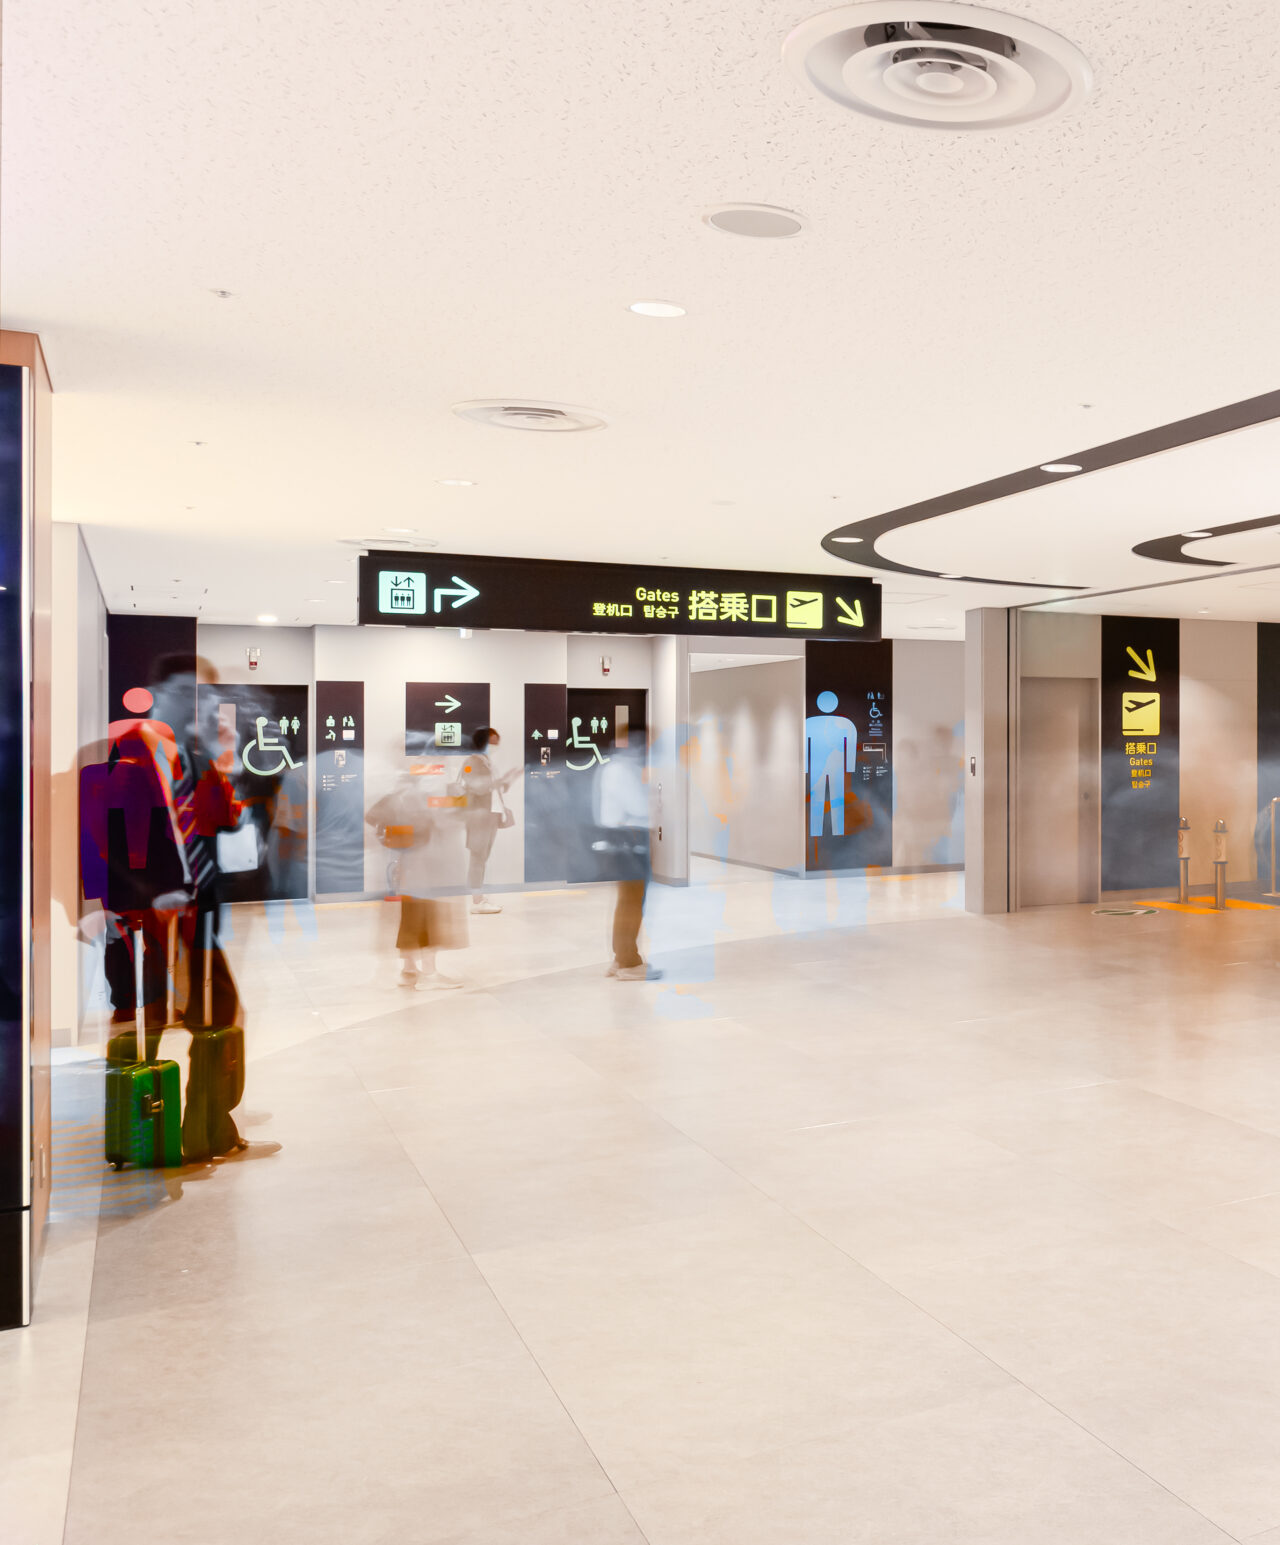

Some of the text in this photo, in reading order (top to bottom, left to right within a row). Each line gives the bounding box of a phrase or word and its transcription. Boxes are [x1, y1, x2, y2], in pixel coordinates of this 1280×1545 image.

[635, 587, 680, 603] Gates
[592, 602, 633, 617] 登机口
[643, 604, 680, 619] 탑승구
[688, 590, 777, 623] 搭乗口
[1125, 742, 1157, 755] 搭乗口
[1129, 757, 1153, 766] Gates
